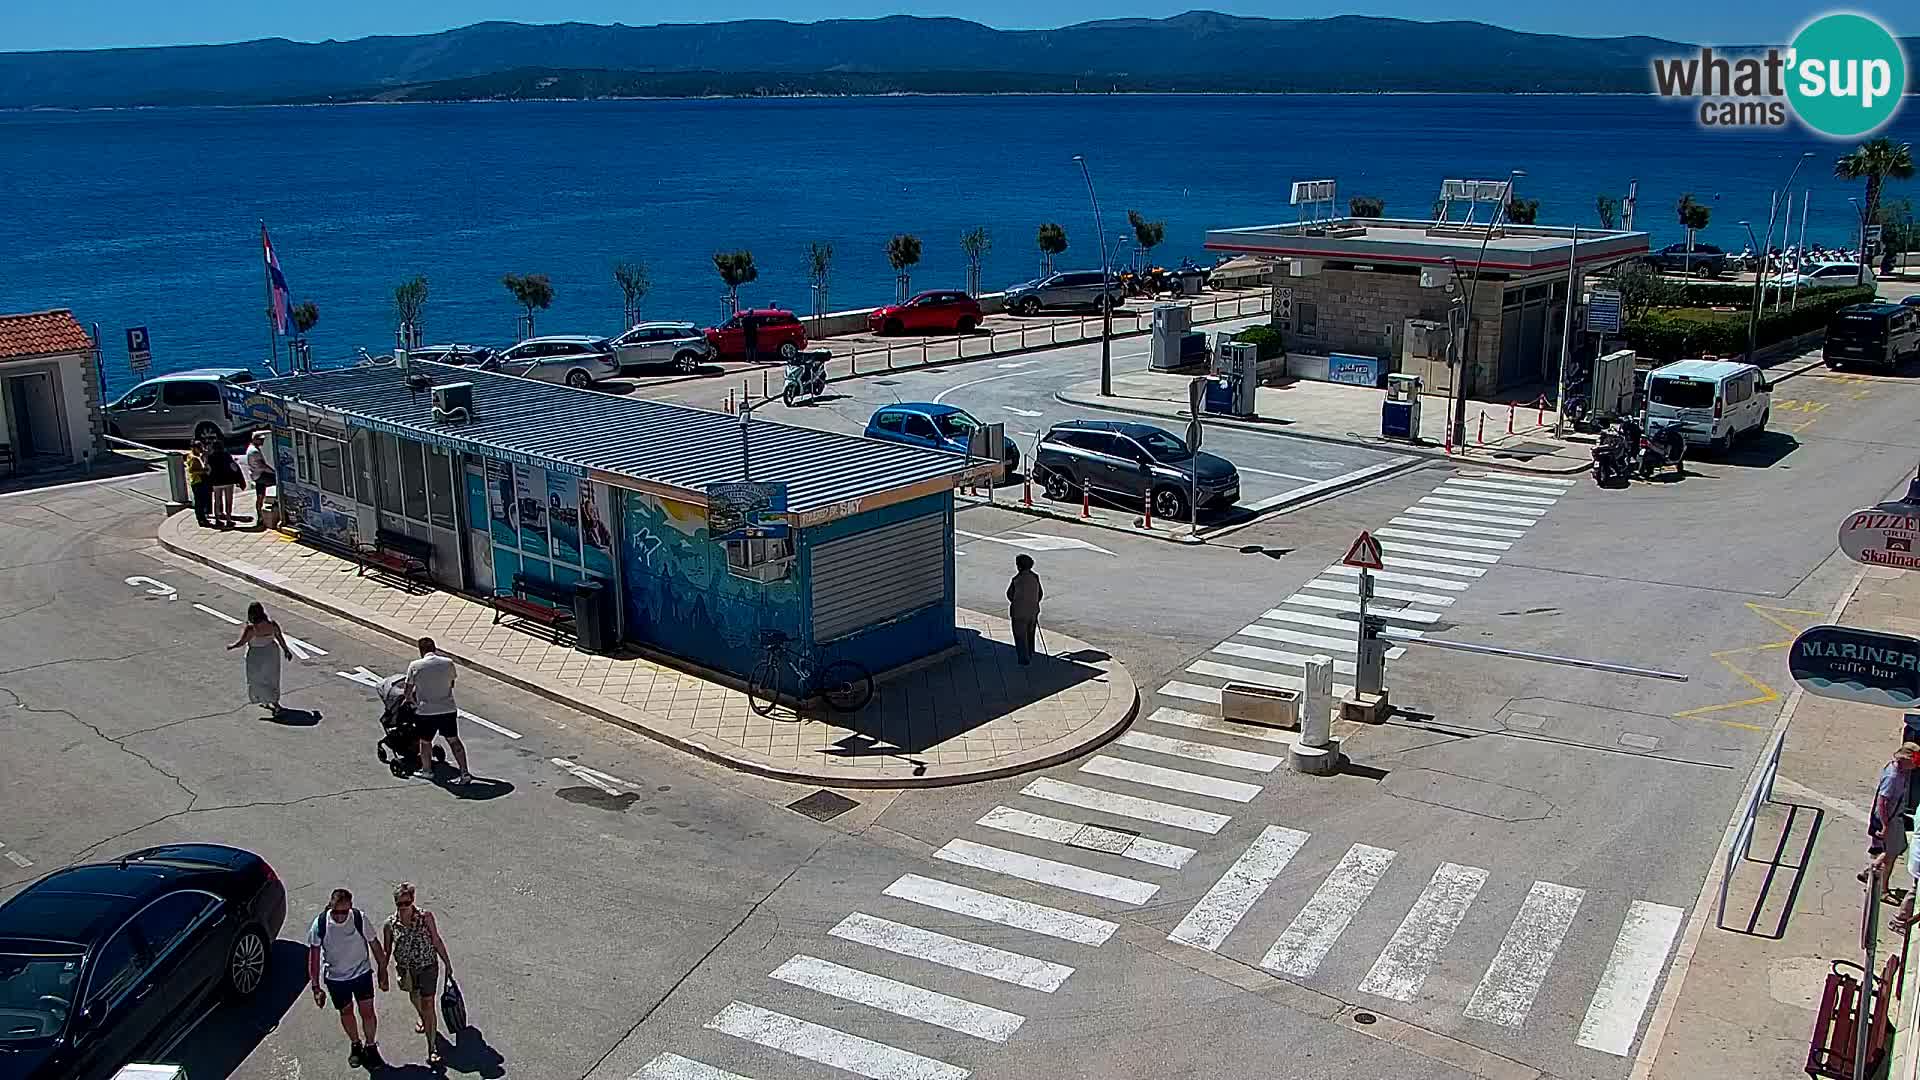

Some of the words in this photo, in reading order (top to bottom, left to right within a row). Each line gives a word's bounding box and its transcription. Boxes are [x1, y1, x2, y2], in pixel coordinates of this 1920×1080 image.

[131, 331, 143, 348] P
[495, 448, 527, 465] STATION
[530, 456, 555, 471] TICKET
[556, 463, 583, 476] OFFICE
[1850, 515, 1920, 532] PIZZE
[1802, 641, 1920, 672] MARINER
[1830, 661, 1866, 673] caffe
[1872, 665, 1897, 678] bar
